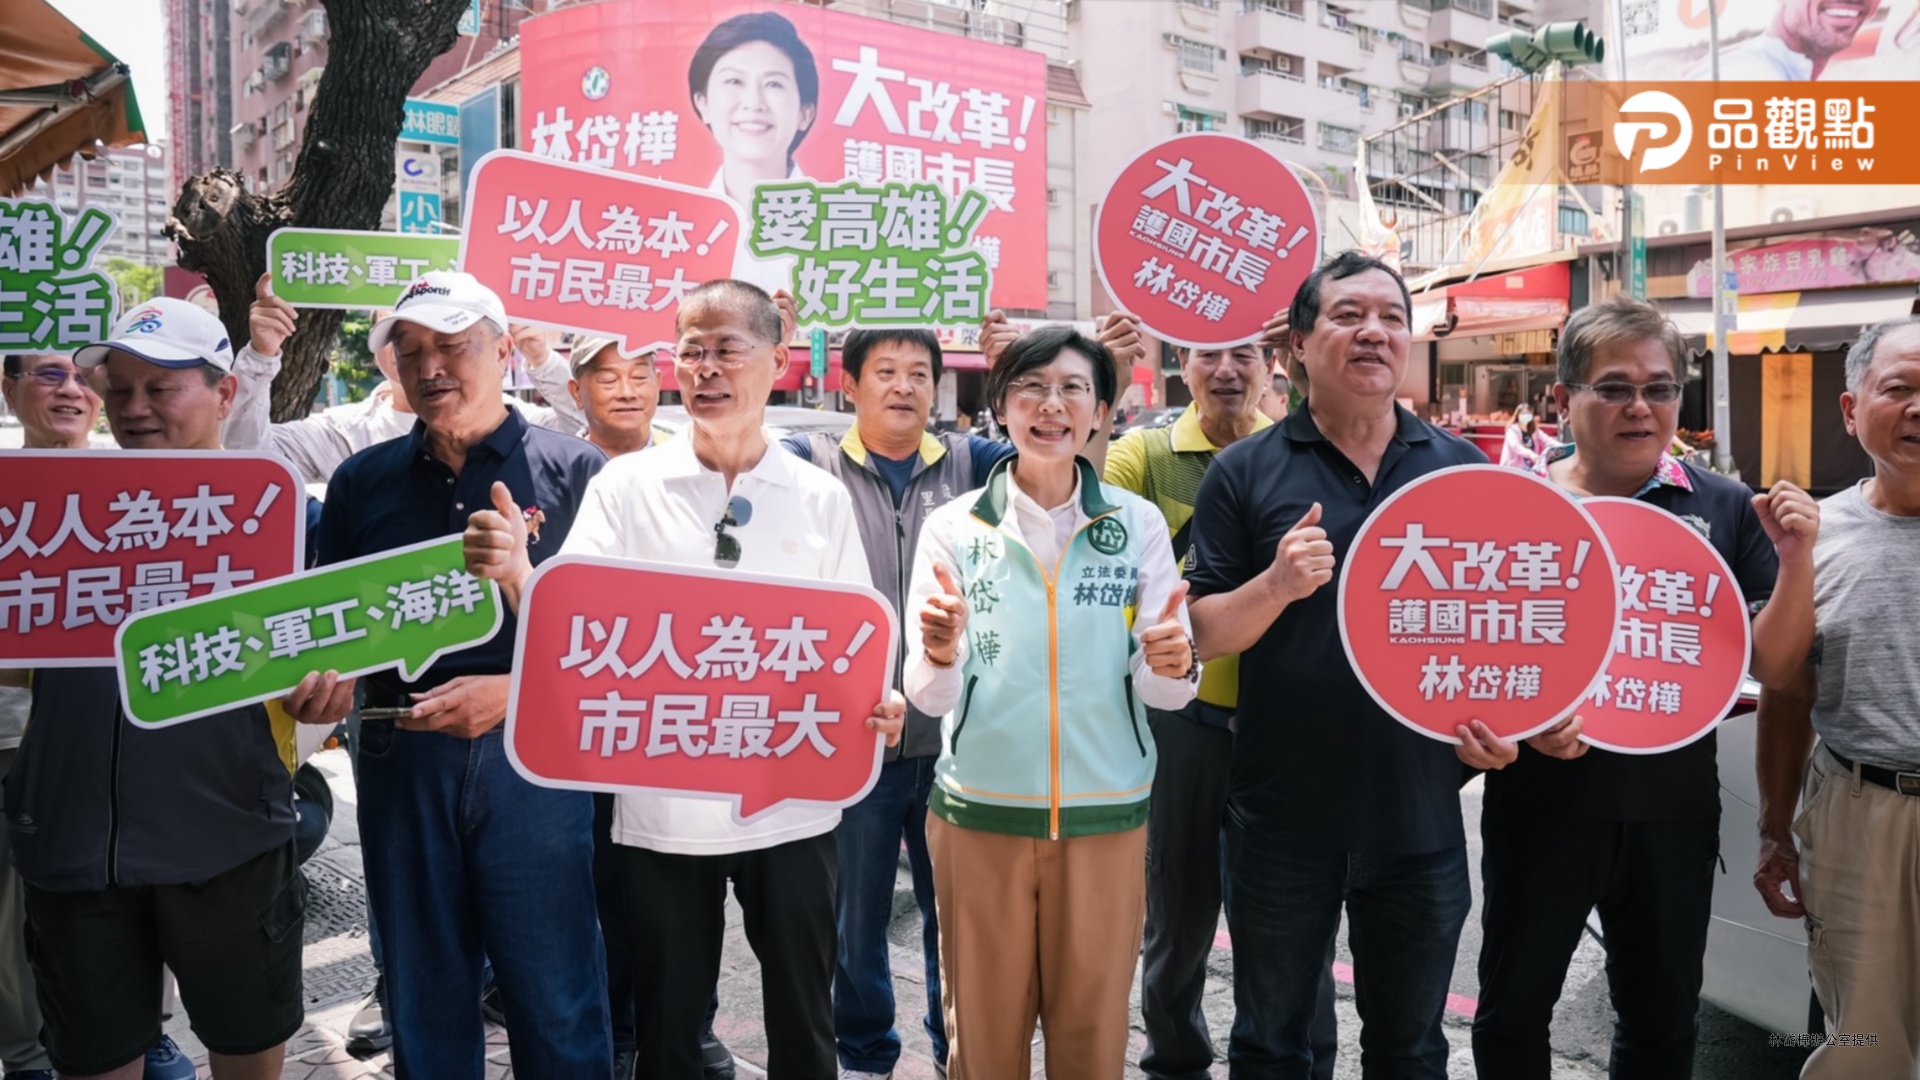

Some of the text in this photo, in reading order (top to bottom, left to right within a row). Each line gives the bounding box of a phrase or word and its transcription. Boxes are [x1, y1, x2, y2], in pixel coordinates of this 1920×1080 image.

[832, 45, 1036, 152] 大改革!
[531, 106, 679, 168] 林岱樺
[497, 195, 729, 258] 以人為本!
[756, 188, 982, 252] 愛高雄!
[1140, 157, 1310, 259] 大改革!
[1128, 230, 1187, 260] KAOHSIUNG
[1131, 204, 1271, 294] 護國市長
[509, 252, 700, 312] 市民最大
[798, 256, 983, 321] 好生活
[1133, 256, 1231, 322] 林岱樺
[1093, 518, 1122, 550] 岱
[1379, 523, 1592, 592] 大改革!
[138, 567, 486, 695] 科技、軍工、海洋
[967, 535, 1001, 667] 林岱樺
[1389, 599, 1566, 644] 護國市長
[560, 614, 876, 683] 以人為本!
[1389, 636, 1466, 644] KAOHSIUNG
[1418, 655, 1542, 701] 林岱樺
[577, 691, 841, 758] 市民最大
